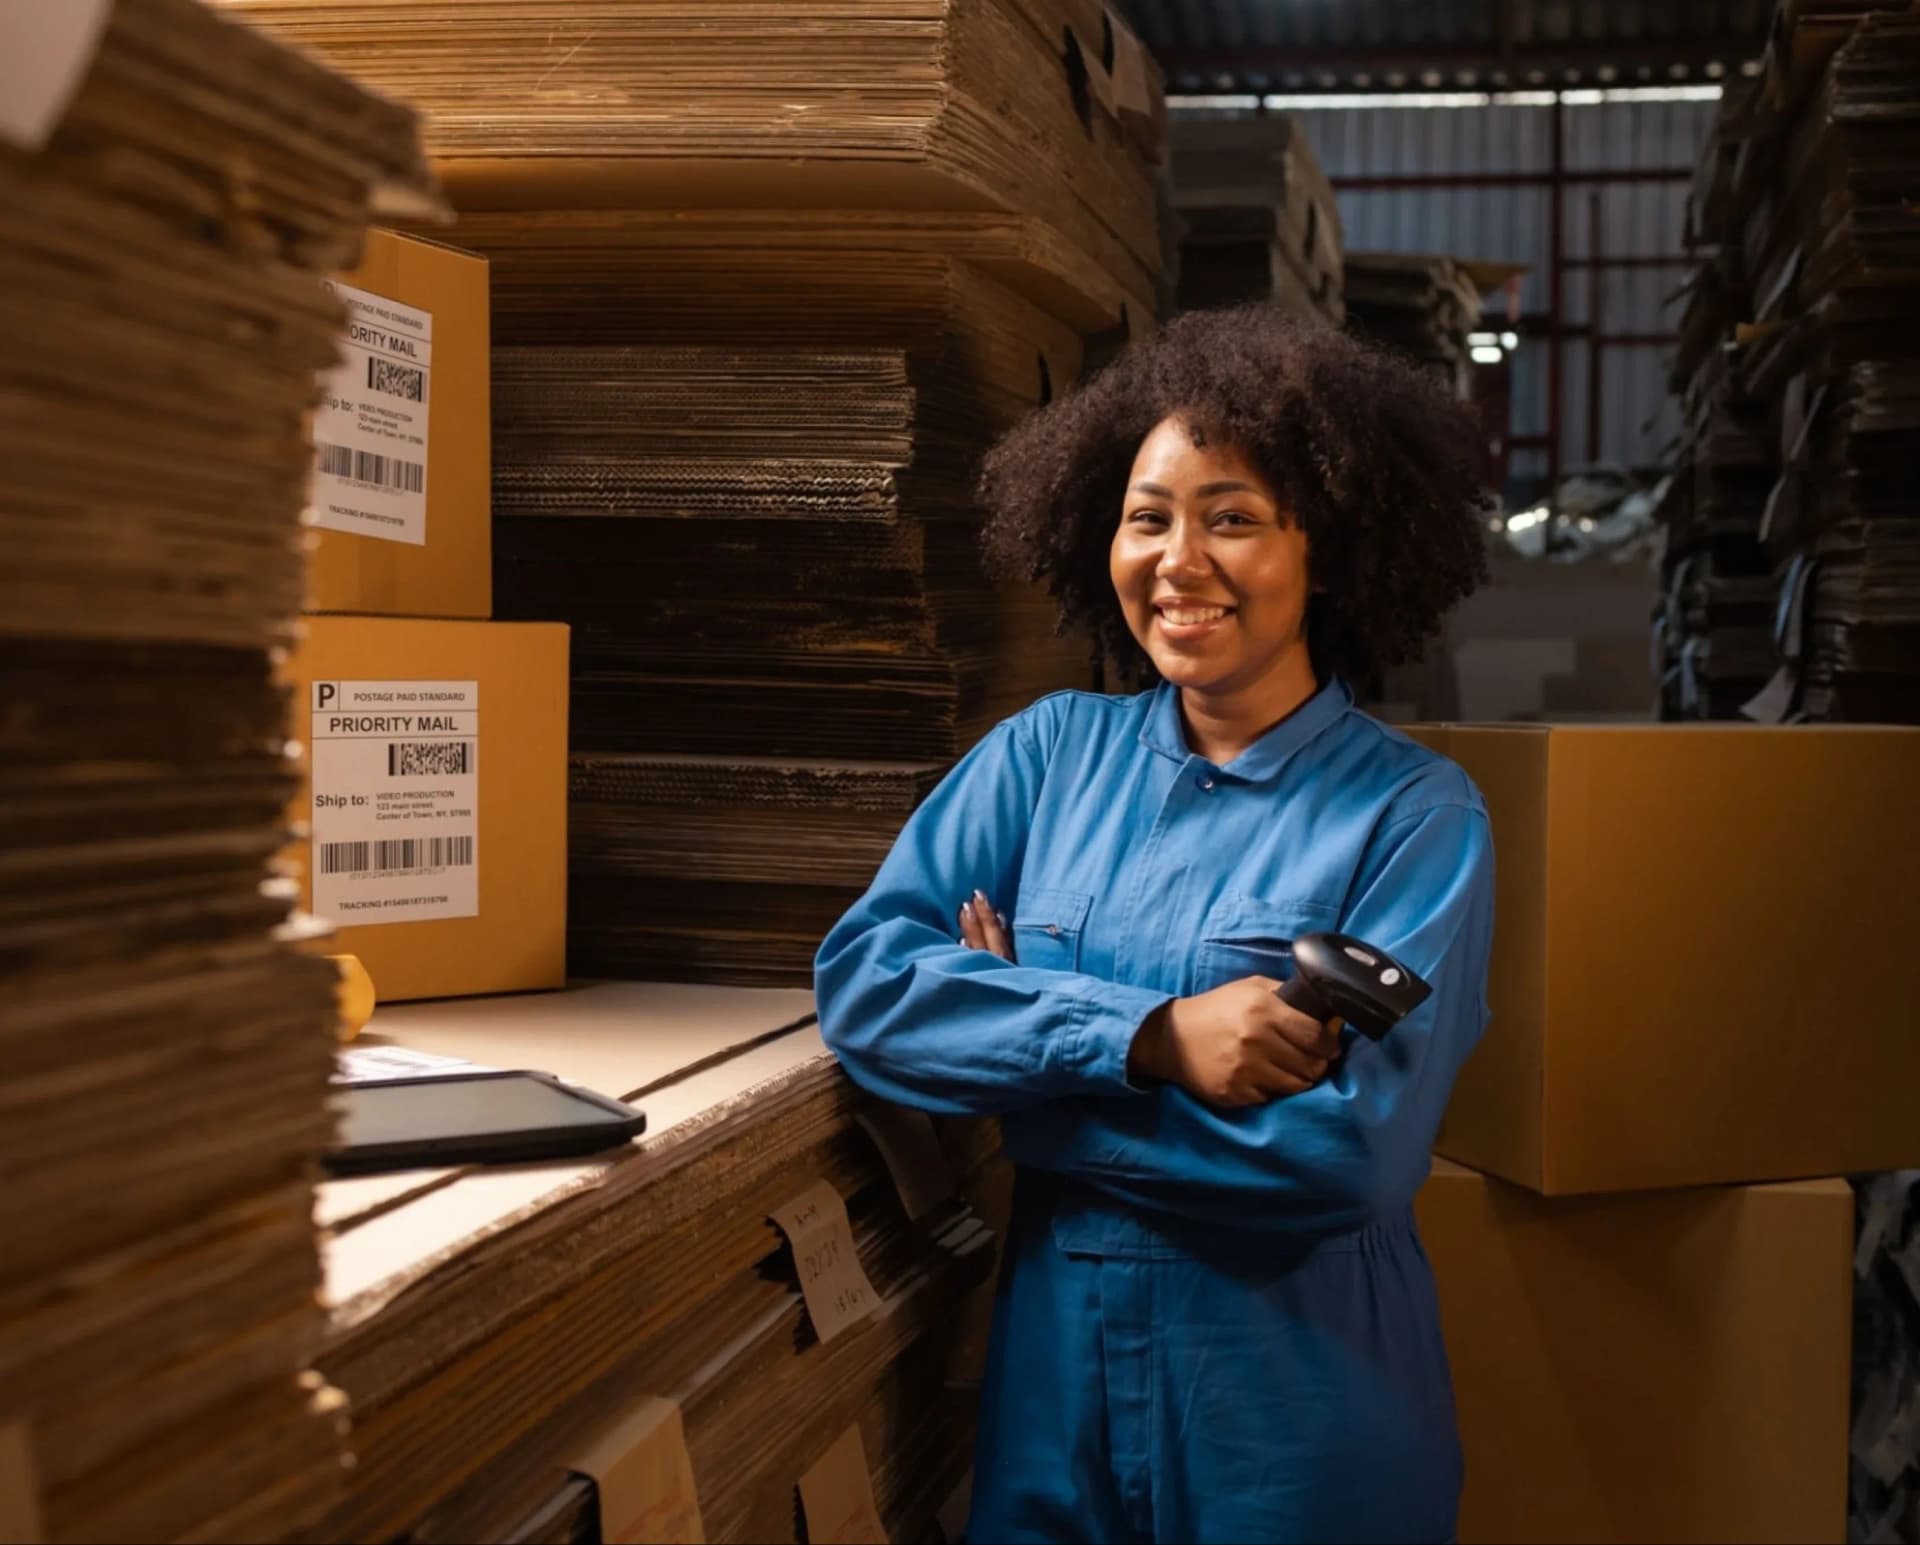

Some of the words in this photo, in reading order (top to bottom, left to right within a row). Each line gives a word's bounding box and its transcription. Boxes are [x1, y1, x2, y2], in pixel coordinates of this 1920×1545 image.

[350, 324, 387, 348] ORITY
[389, 336, 417, 358] MAIL
[318, 683, 336, 709] P
[354, 692, 394, 702] POSTAGE
[396, 692, 417, 702] PAID
[419, 692, 466, 701] STANDARD
[329, 716, 412, 733] PRIORITY
[417, 716, 458, 731] MAIL
[376, 792, 401, 800] VIDEO
[402, 790, 455, 799] PRODUCTION
[315, 794, 347, 809] Ship
[351, 795, 369, 806] to:
[376, 803, 390, 811] 123
[376, 812, 401, 820] Center
[339, 901, 381, 911] TRACKING
